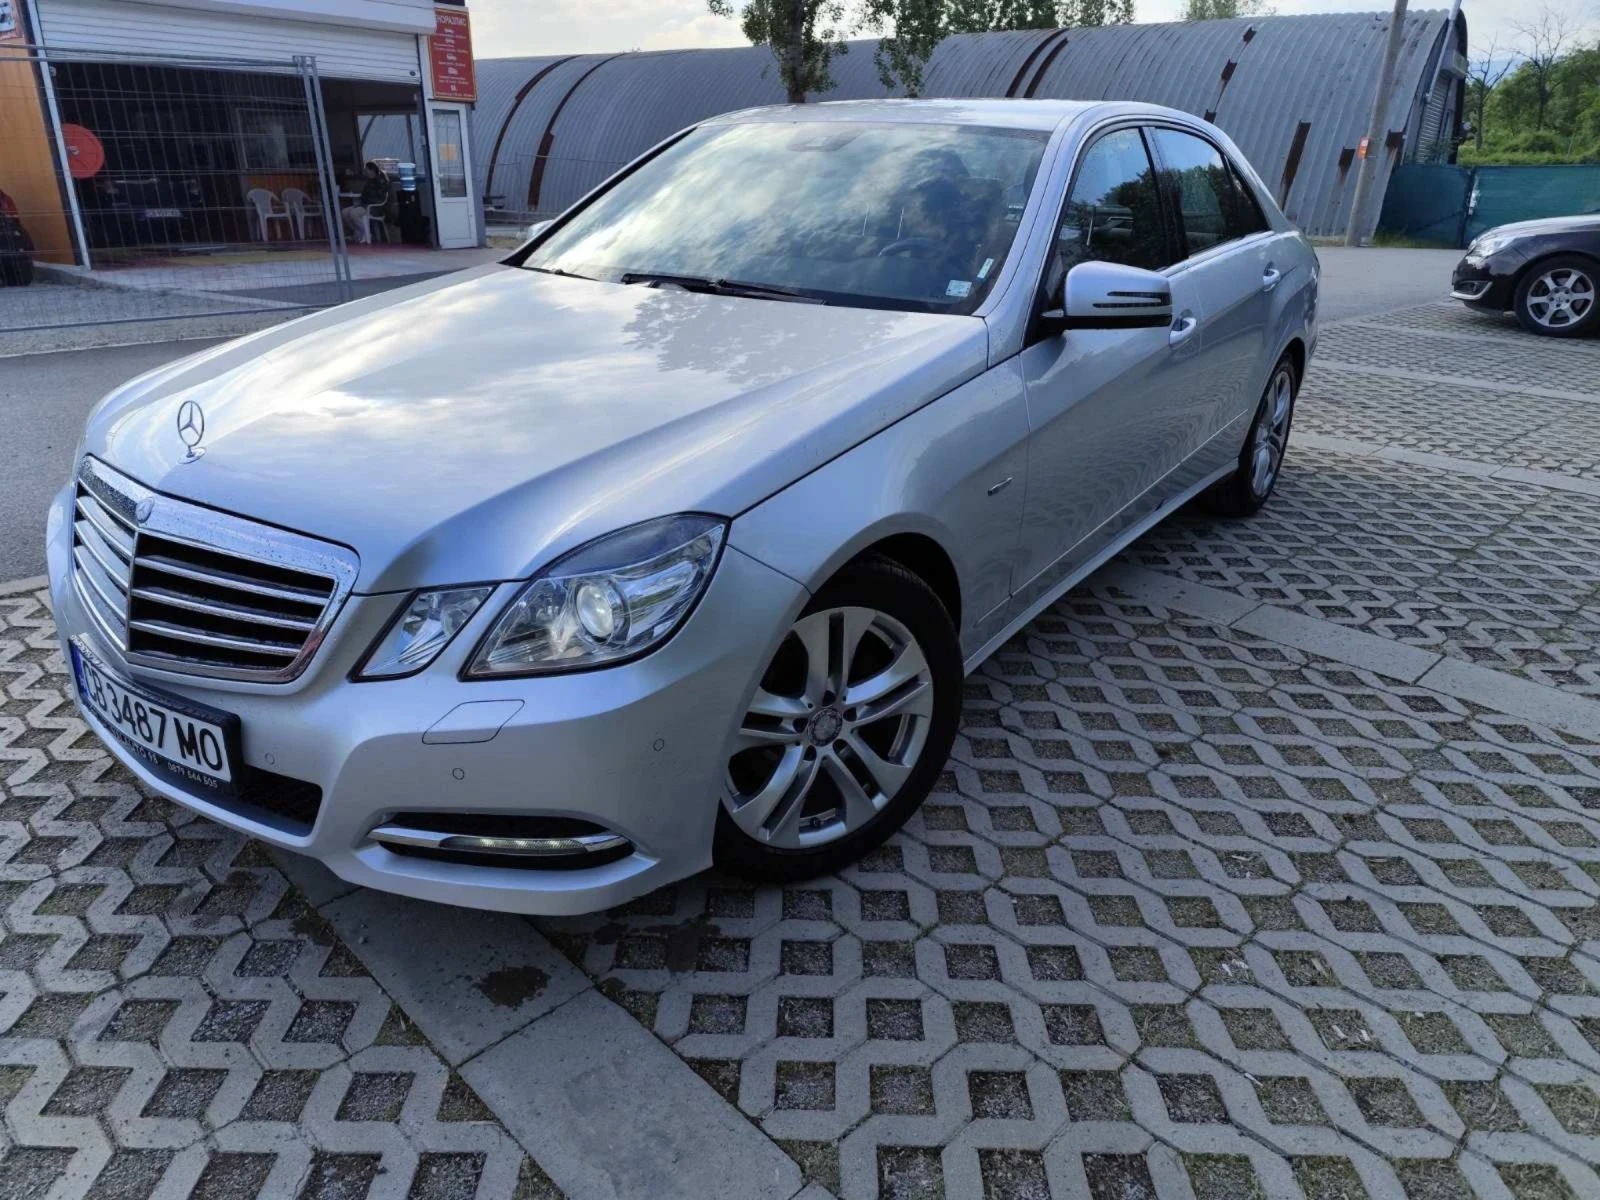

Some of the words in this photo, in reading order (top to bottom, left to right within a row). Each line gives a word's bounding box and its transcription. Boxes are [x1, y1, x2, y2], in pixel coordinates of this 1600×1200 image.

[82, 659, 108, 712] CB
[106, 682, 167, 749] 3487
[173, 717, 224, 771] MO
